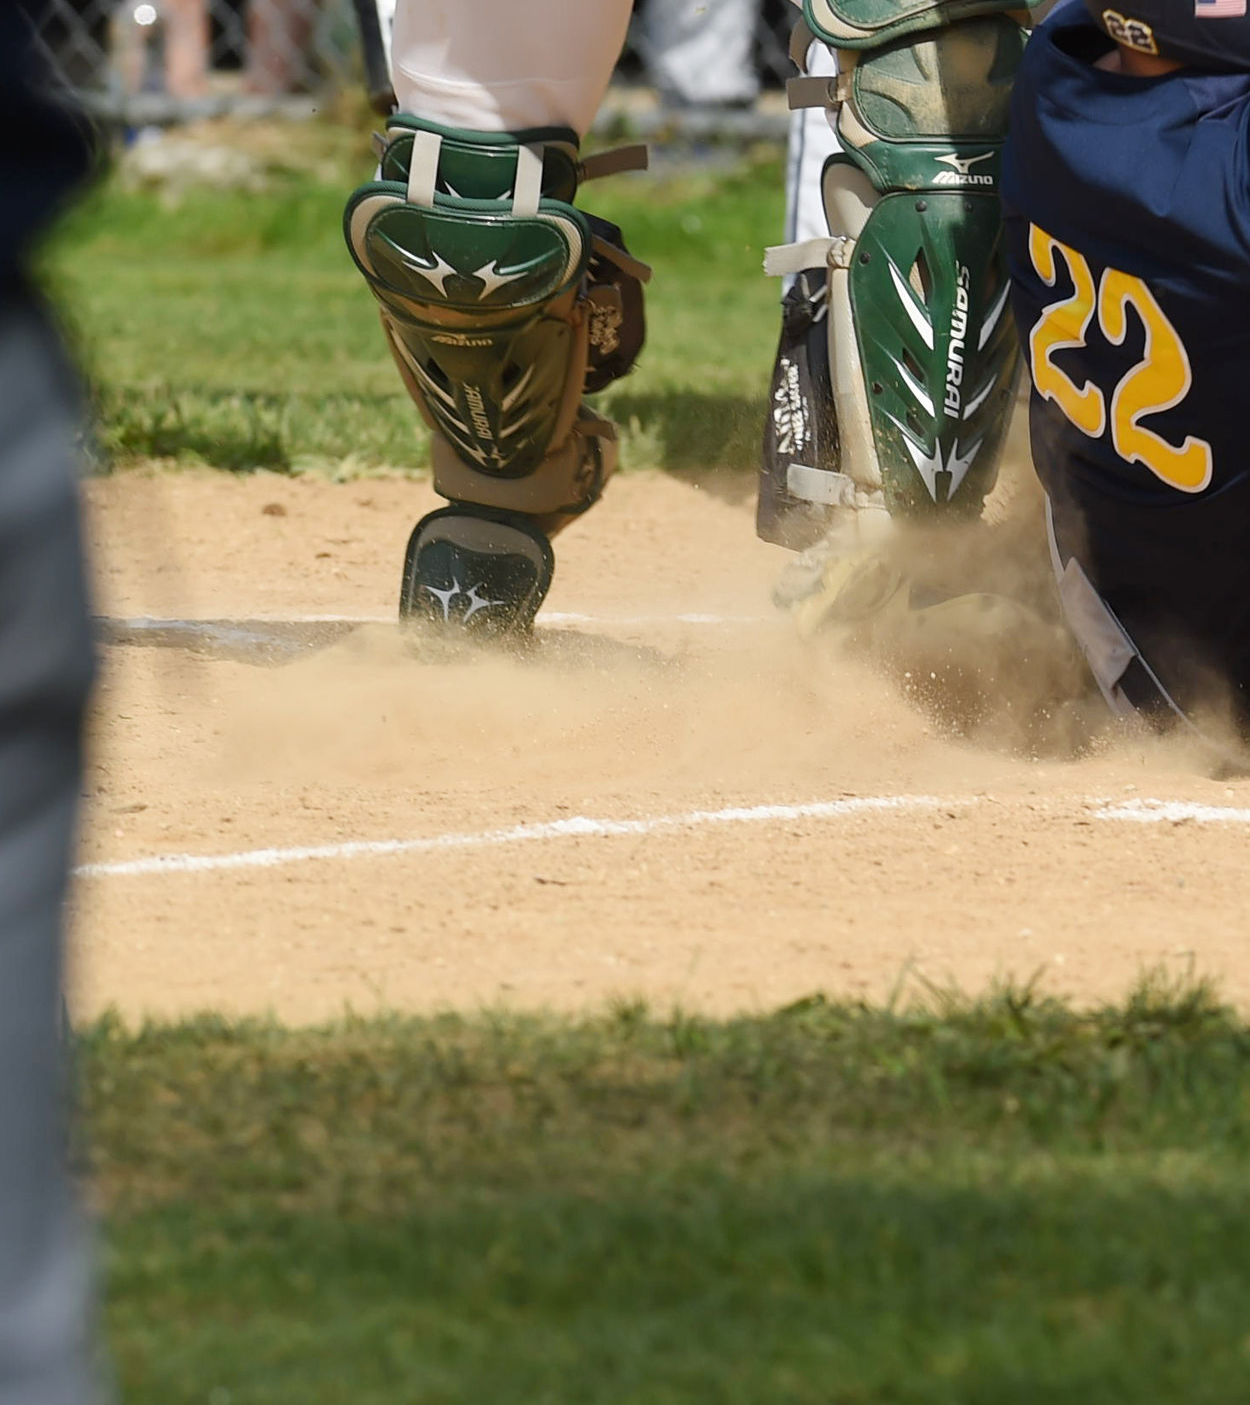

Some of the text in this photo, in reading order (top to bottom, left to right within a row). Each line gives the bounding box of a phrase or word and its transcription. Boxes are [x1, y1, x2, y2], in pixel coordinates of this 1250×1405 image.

[1102, 8, 1159, 56] 22
[931, 171, 994, 185] MIZUNO
[943, 259, 970, 420] SAMURAI
[1028, 221, 1214, 494] 22
